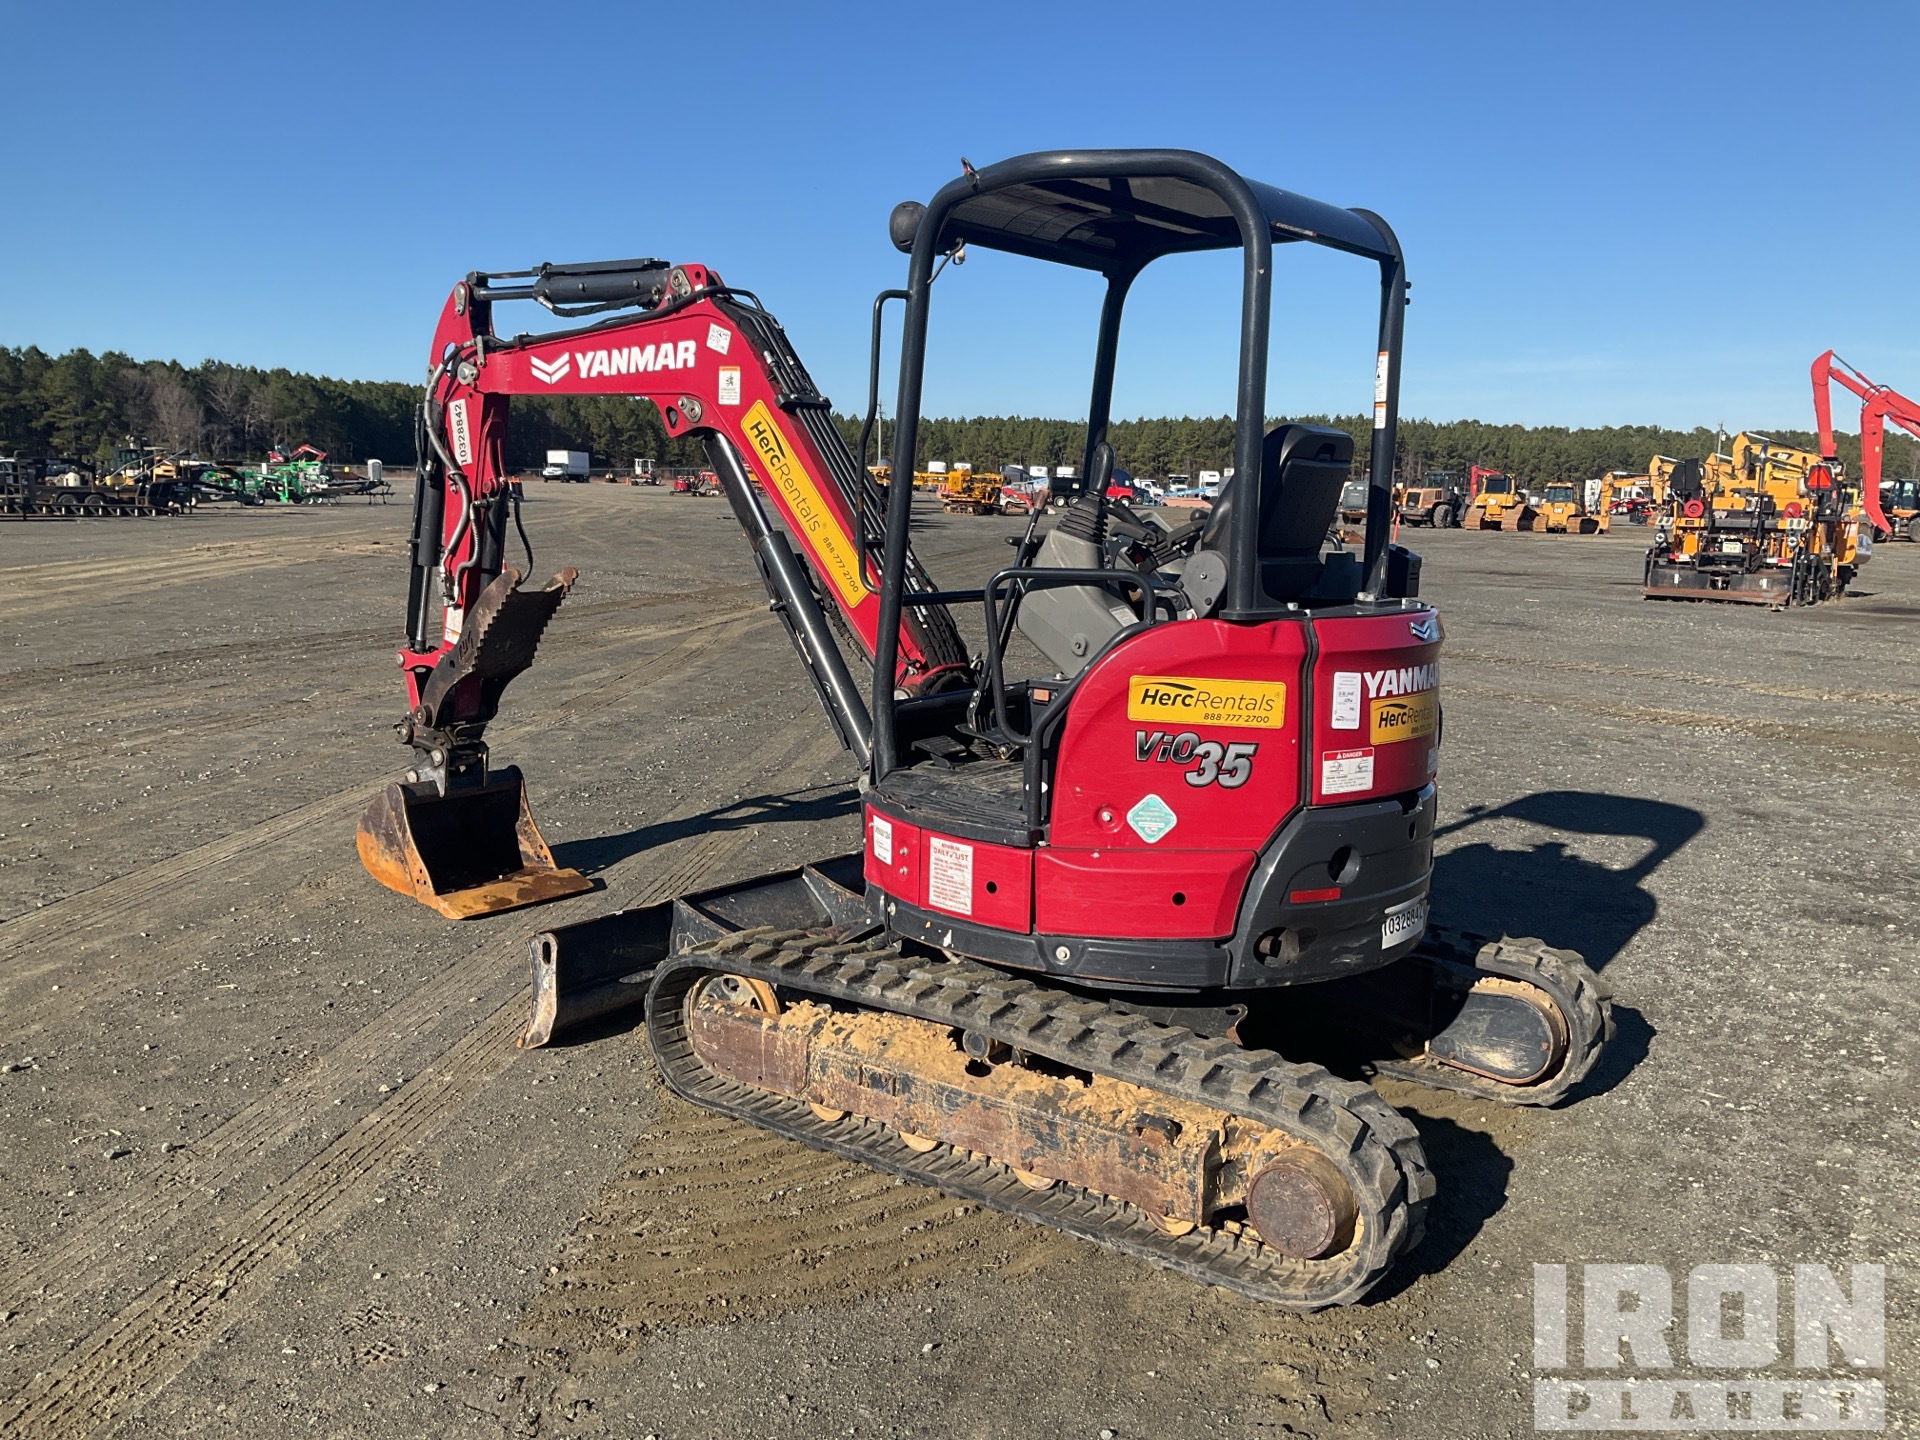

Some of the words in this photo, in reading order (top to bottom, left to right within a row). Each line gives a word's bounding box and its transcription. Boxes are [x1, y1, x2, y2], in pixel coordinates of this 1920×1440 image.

[575, 340, 696, 378] YANMAR
[454, 403, 468, 464] 10328842
[822, 536, 859, 592] 888-777-2700
[1140, 688, 1275, 712] HercRentals
[1203, 712, 1270, 724] 888-777-2700
[1342, 751, 1363, 759] DANGER
